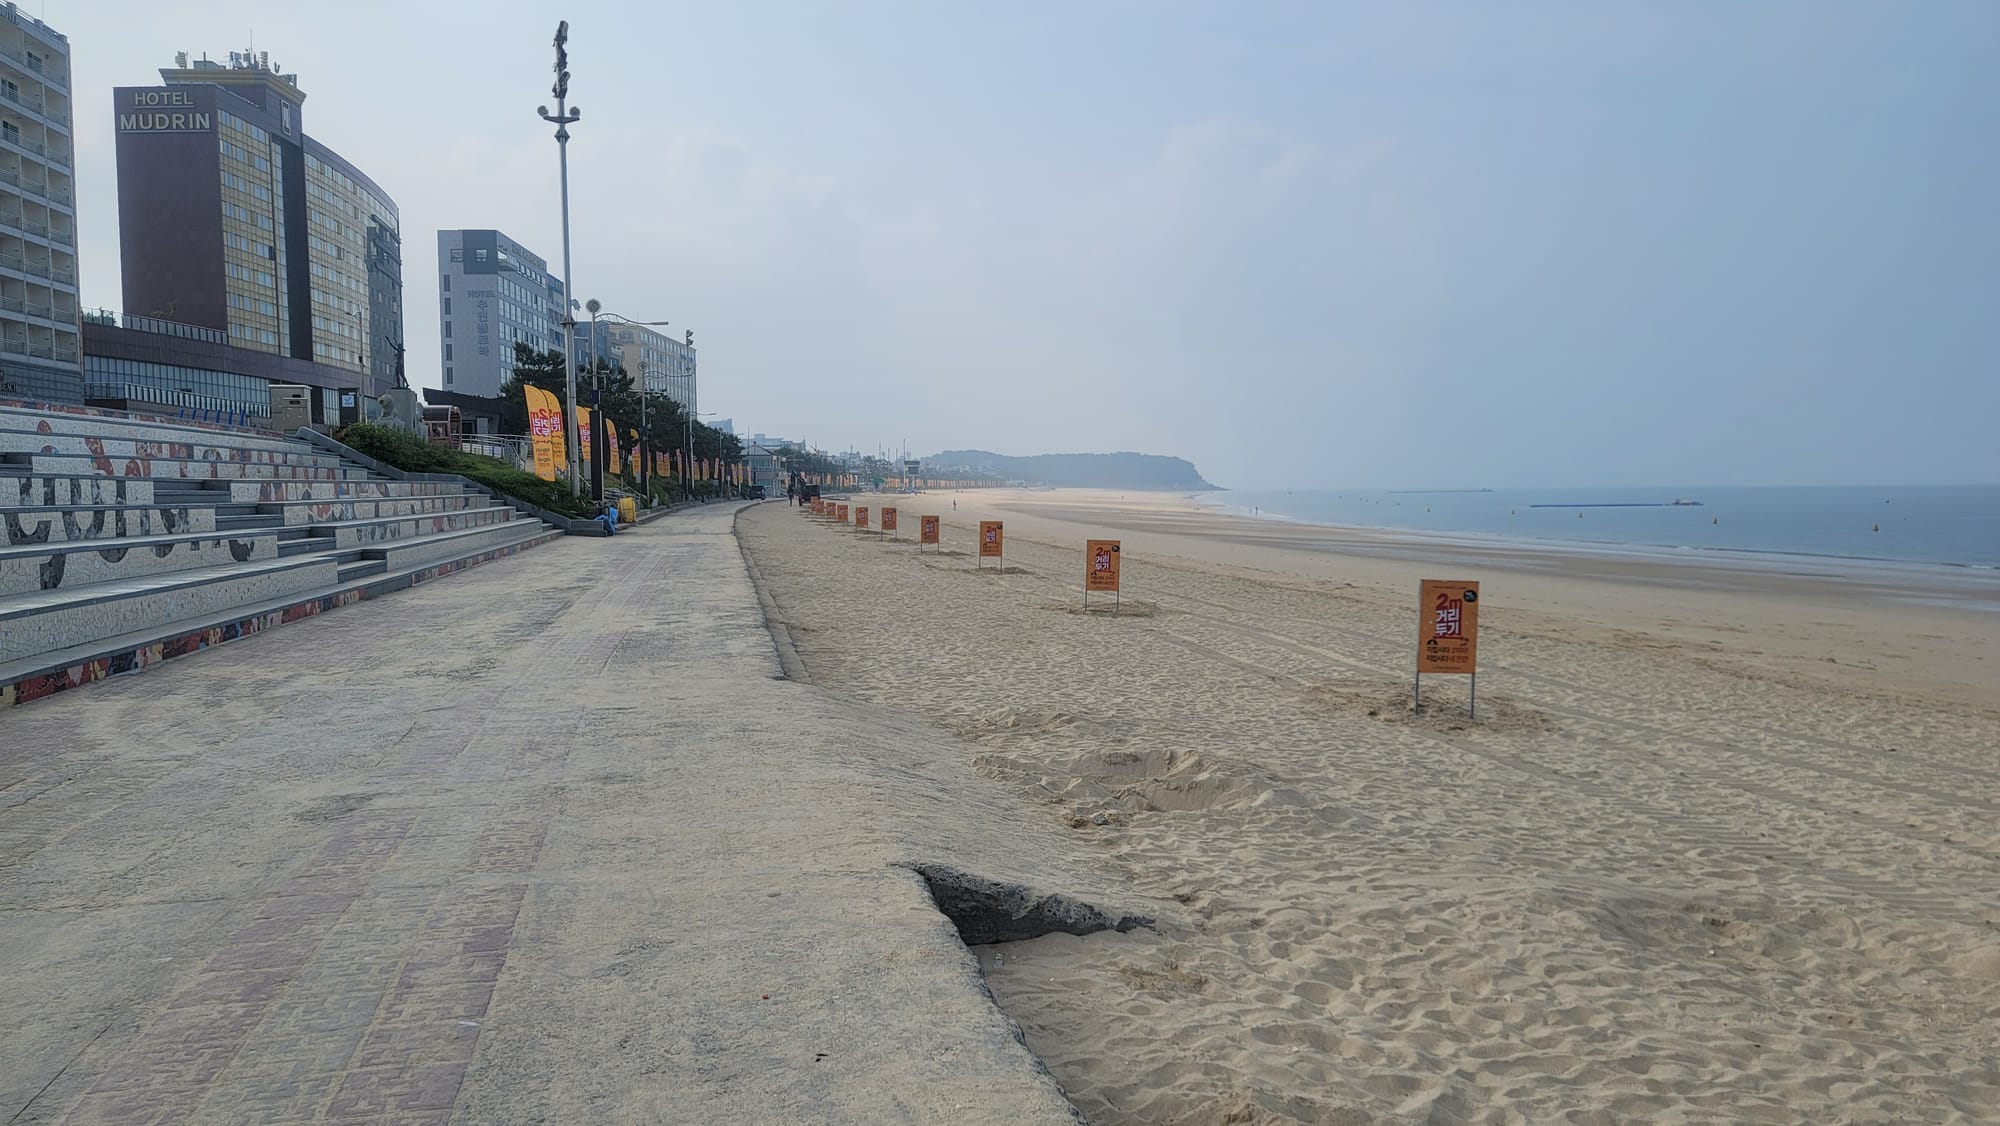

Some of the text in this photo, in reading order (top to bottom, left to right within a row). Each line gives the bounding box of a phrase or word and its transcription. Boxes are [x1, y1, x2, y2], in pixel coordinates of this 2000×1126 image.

[135, 92, 194, 105] HOTEL
[120, 113, 210, 130] MUDRIN
[1436, 593, 1462, 610] 2m
[1435, 608, 1459, 622] 거리
[1435, 622, 1459, 636] 두기
